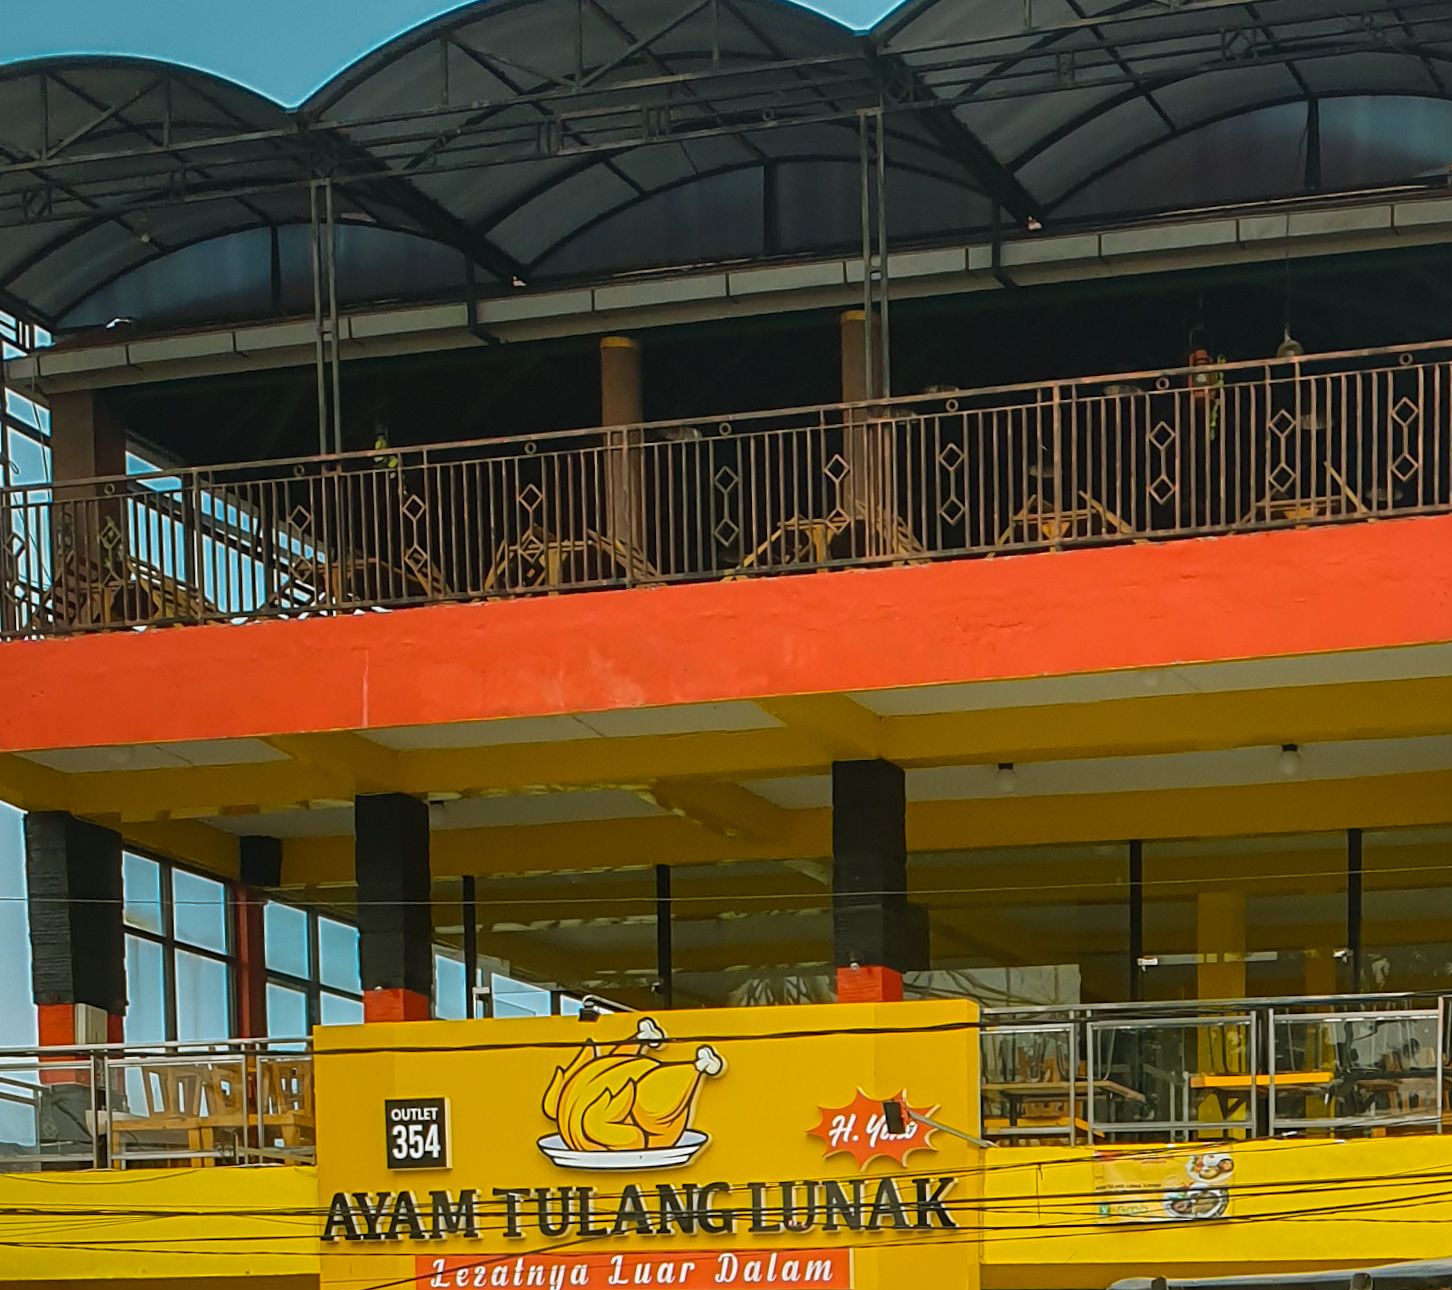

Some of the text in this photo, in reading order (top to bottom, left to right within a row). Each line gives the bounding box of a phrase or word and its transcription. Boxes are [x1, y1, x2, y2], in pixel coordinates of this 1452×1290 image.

[391, 1107, 439, 1121] OUTLET
[829, 1113, 917, 1148] H. Yuo
[392, 1123, 441, 1159] 354
[320, 1177, 958, 1241] AYAM TULANG LUNAK
[607, 1254, 696, 1285] Luar
[714, 1251, 833, 1283] Dalam
